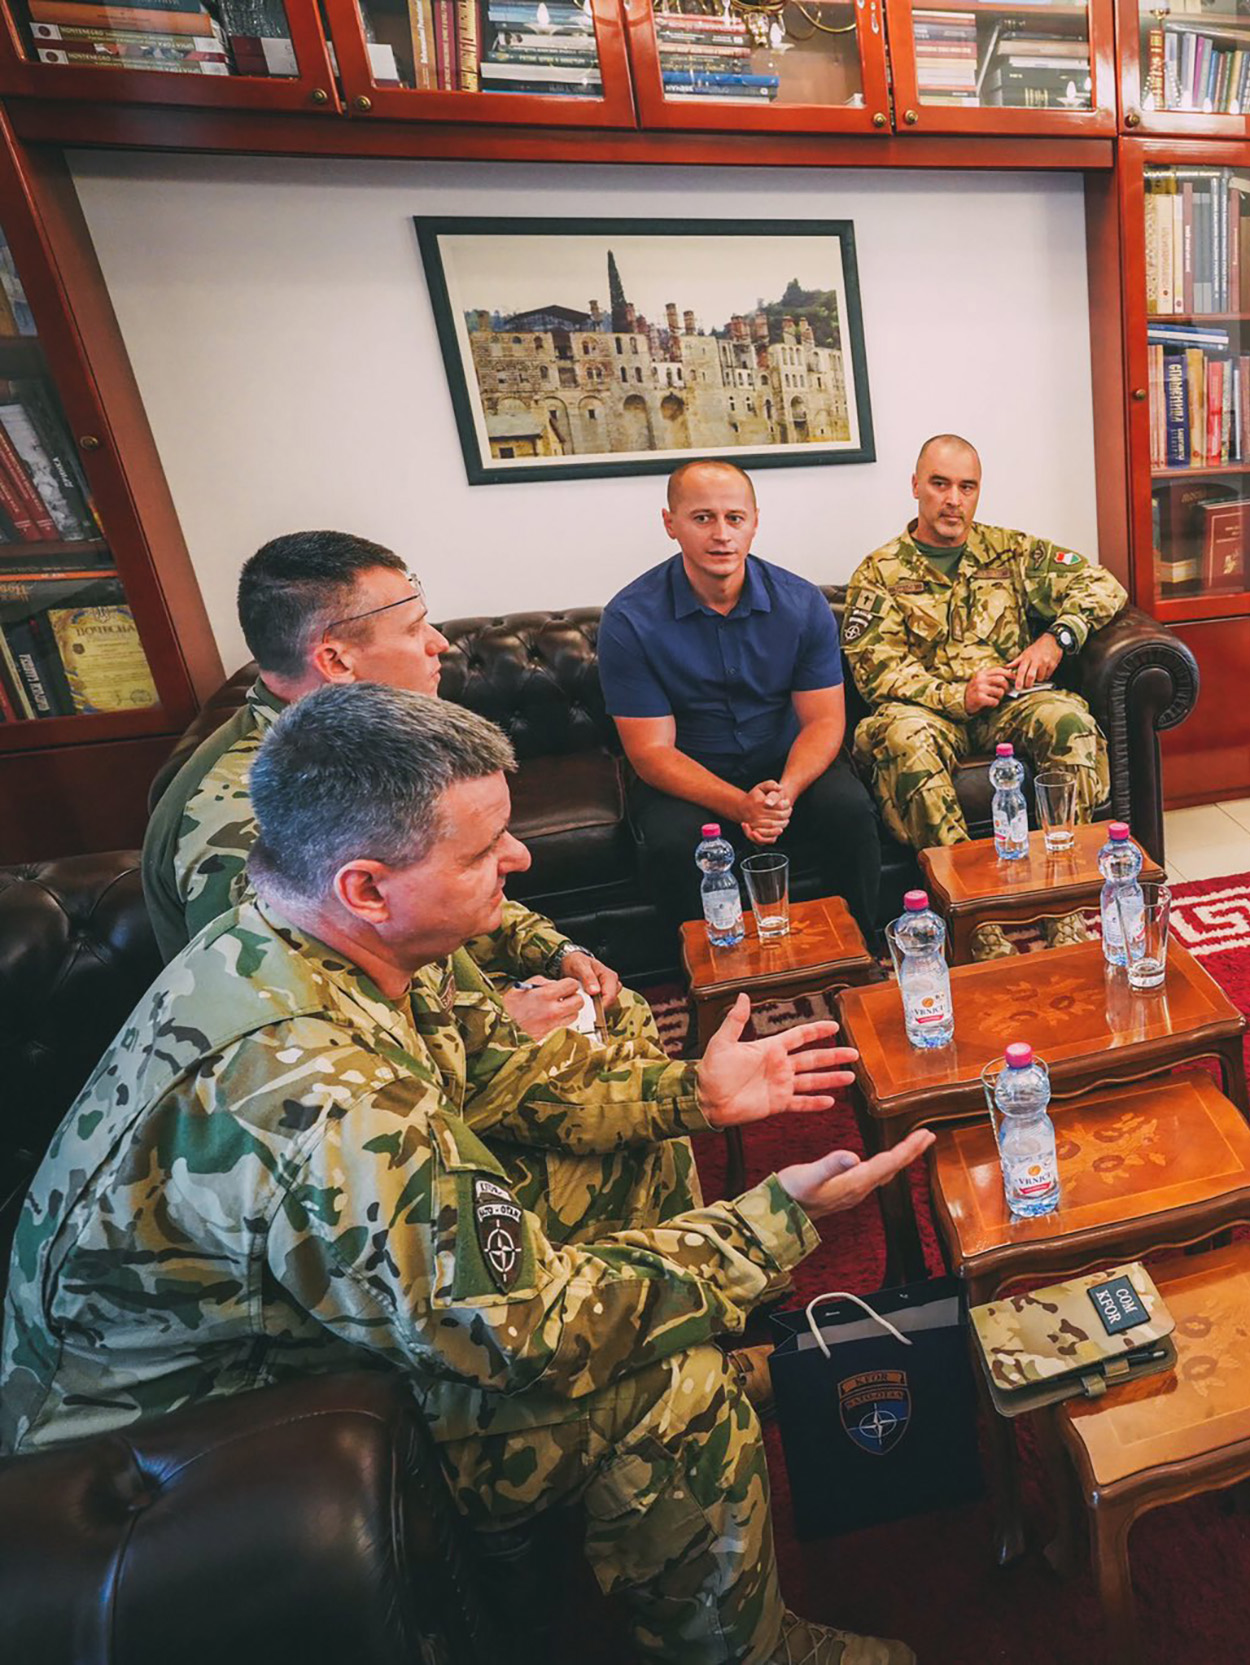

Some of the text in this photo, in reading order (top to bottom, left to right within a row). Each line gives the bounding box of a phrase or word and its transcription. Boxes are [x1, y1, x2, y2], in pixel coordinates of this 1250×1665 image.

[60, 27, 104, 36] MONTENEGRO
[68, 53, 112, 61] MONTENEGRO
[1018, 1172, 1051, 1185] VRNJCI
[1096, 1289, 1121, 1324] KFOR
[1116, 1288, 1138, 1313] COM
[856, 1374, 888, 1385] KFOR
